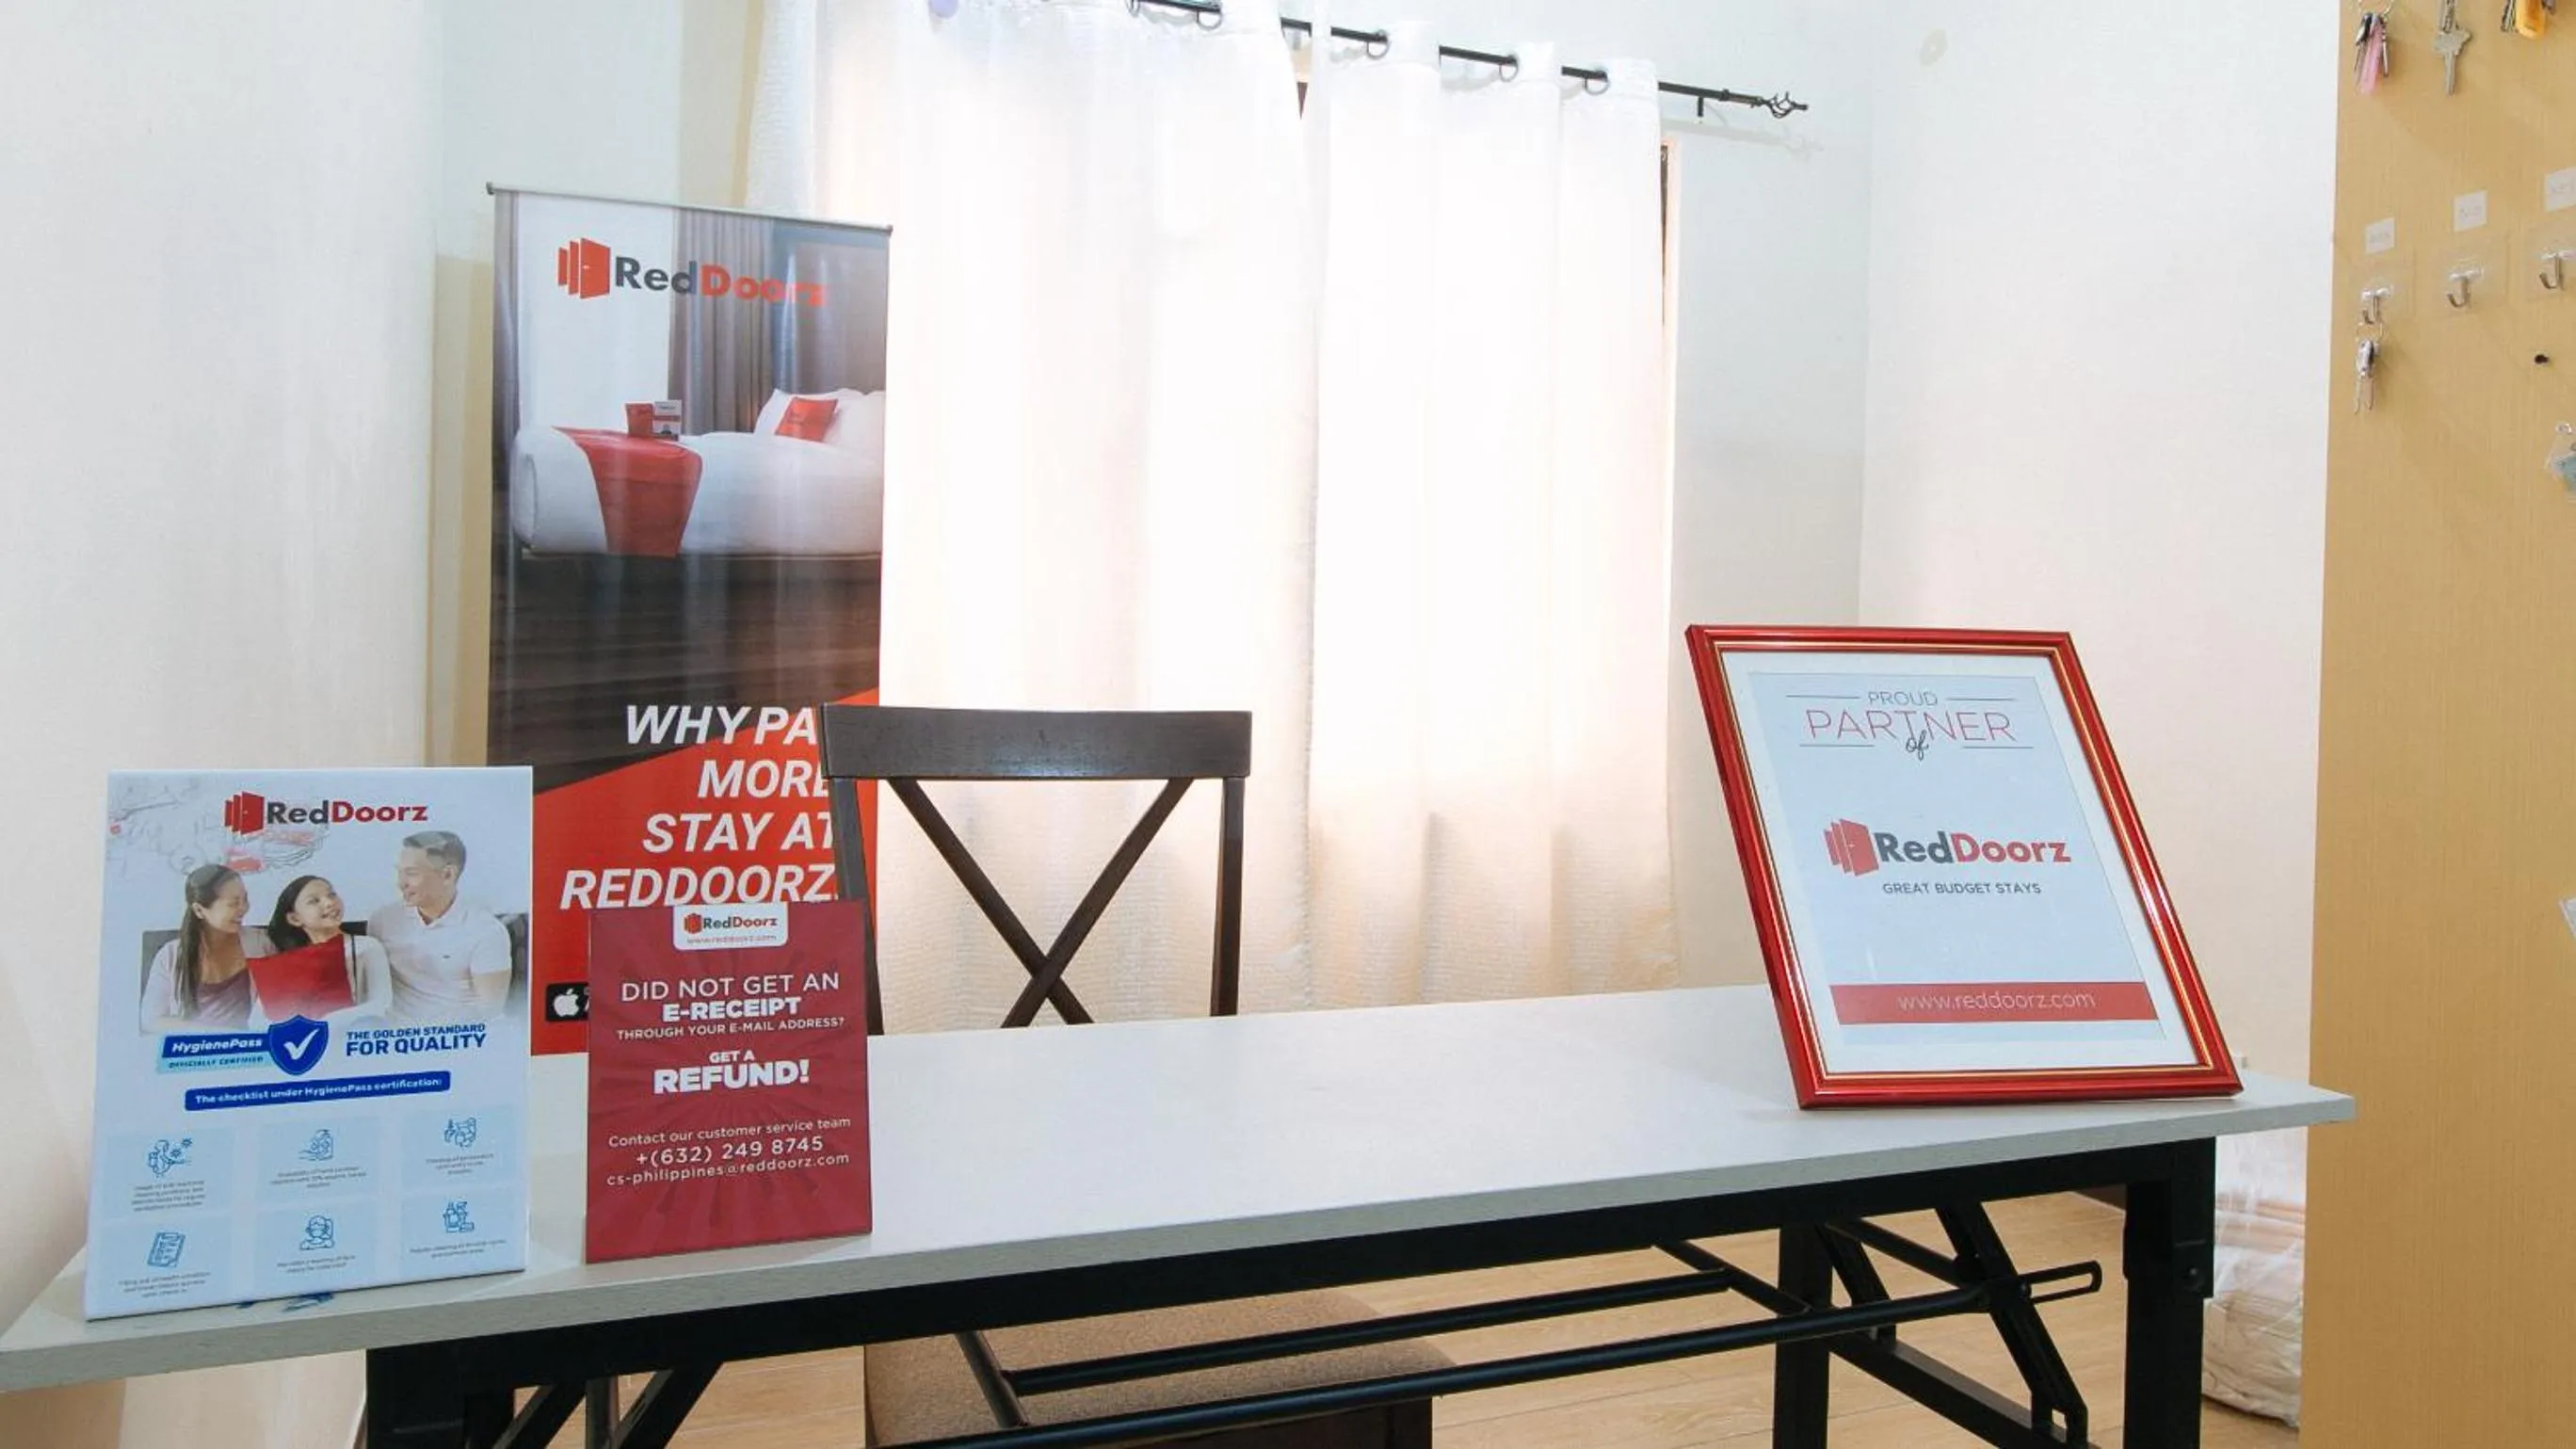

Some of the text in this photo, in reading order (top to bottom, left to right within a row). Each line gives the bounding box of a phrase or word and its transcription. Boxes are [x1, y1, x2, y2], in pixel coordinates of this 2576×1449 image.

[616, 256, 826, 306] RedDoorz
[1867, 691, 1938, 706] PROUD
[626, 705, 817, 745] WHY PA
[1806, 709, 2017, 742] PARTNER
[1906, 730, 1929, 761] of
[267, 800, 428, 825] RedDoorz
[642, 813, 774, 852] STAY
[1873, 830, 2071, 864] RedDoorz
[1883, 882, 2042, 894] GREAT BUDGET STAYS
[702, 916, 778, 929] RedDoorz
[621, 973, 839, 1001] DID NOT GET AN
[663, 996, 802, 1022] E-RECEIPT
[1897, 990, 2097, 1011] www.reddoorz.com
[346, 1022, 486, 1040] THE GOLDEN STANDARD
[618, 1017, 845, 1040] THROUGH YOUR E-MAIL ADDRESS?
[172, 1038, 263, 1054] HygienePass
[346, 1033, 487, 1055] FOR QUALITY
[709, 1050, 755, 1064] GET A
[653, 1058, 810, 1095] REFUND!
[196, 1094, 216, 1104] The
[270, 1087, 302, 1099] under
[608, 1117, 851, 1148] Contact our customer service team
[636, 1135, 824, 1169] +(632) 249 8745
[606, 1153, 850, 1186] cs-philippines@reddoorz.com
